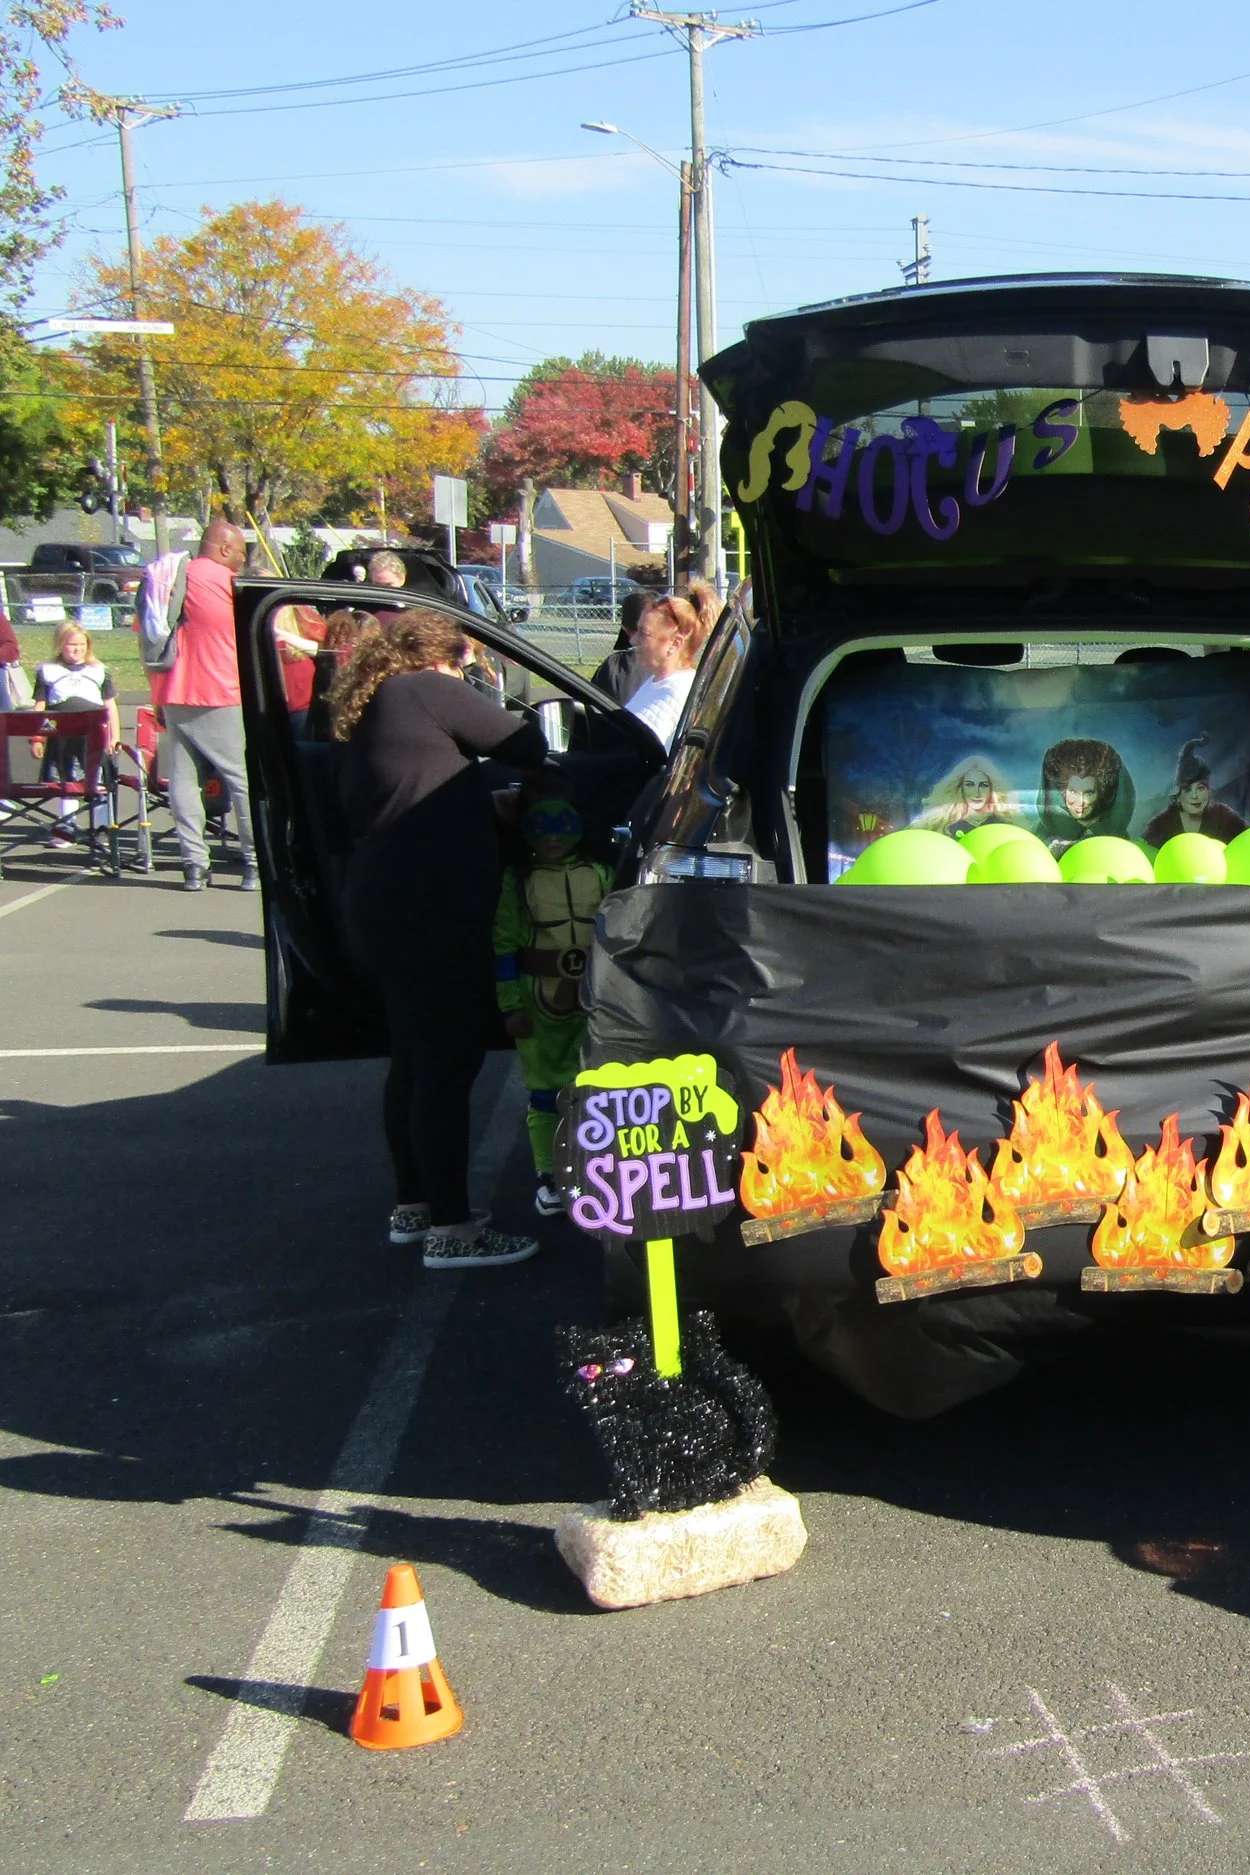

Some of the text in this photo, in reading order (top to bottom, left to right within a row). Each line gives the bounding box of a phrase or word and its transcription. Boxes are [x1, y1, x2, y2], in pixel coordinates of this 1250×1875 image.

[796, 398, 1079, 541] HOCUS
[577, 1085, 708, 1151] STOP BY
[617, 1120, 690, 1158] FOR A
[572, 1149, 735, 1234] SPELL
[392, 1620, 411, 1657] 1
